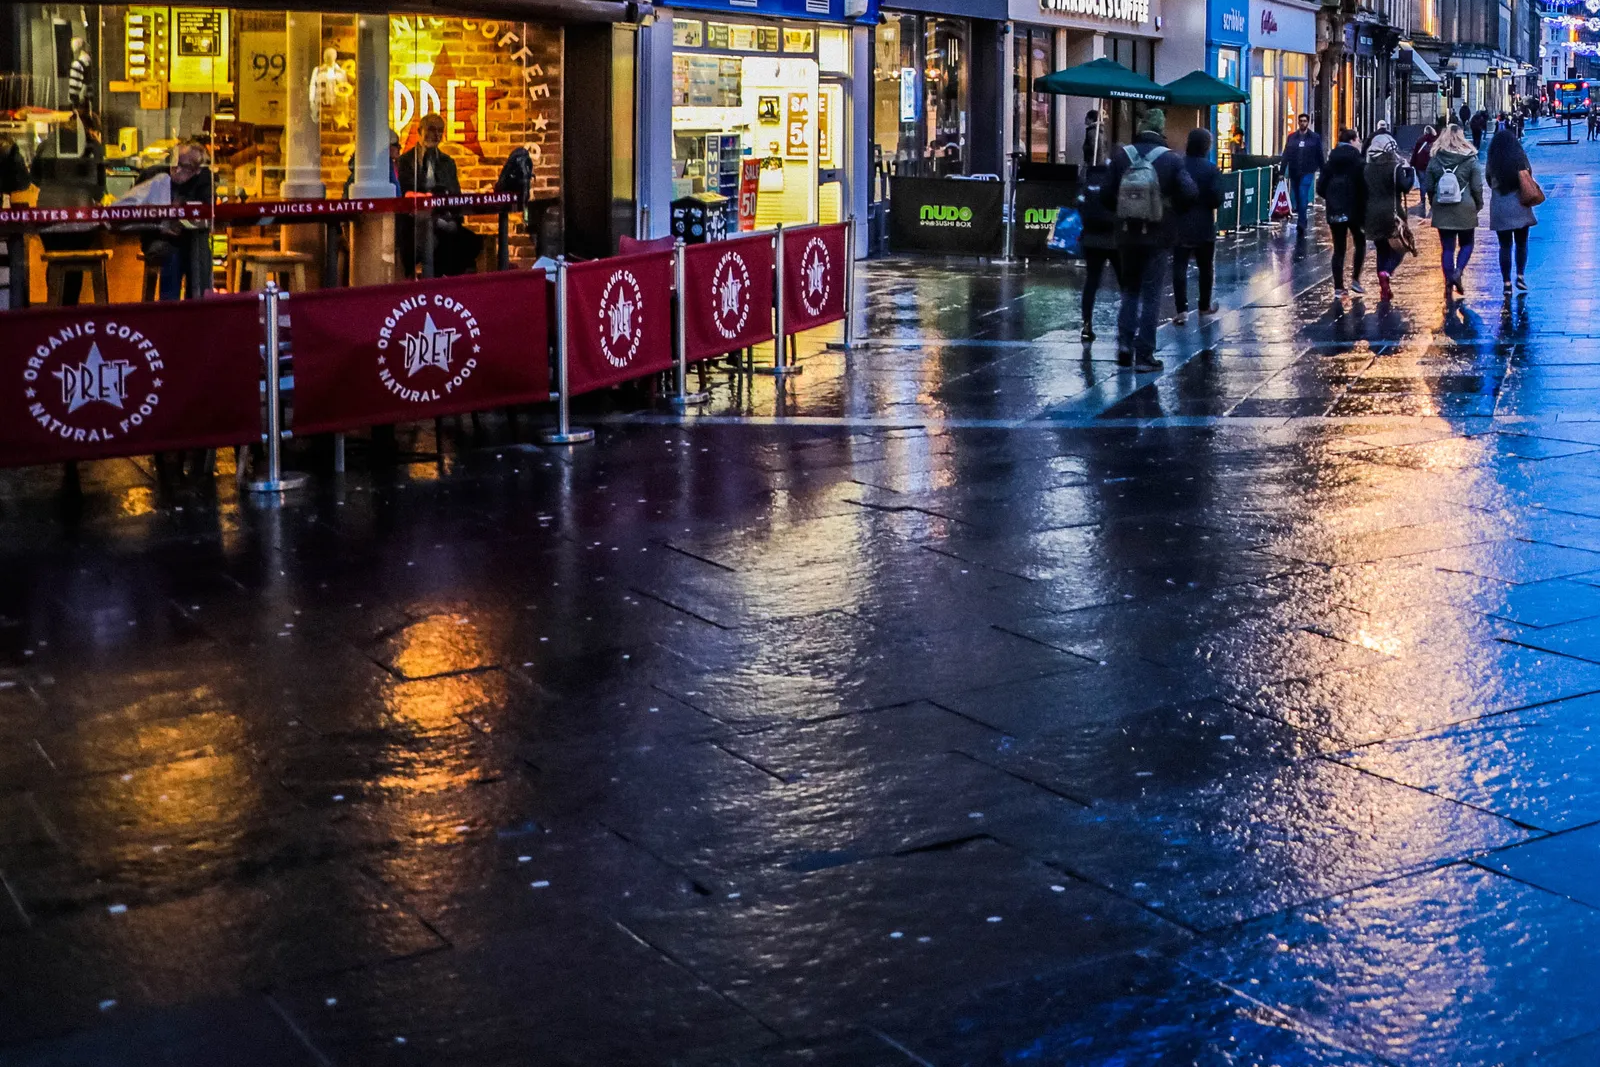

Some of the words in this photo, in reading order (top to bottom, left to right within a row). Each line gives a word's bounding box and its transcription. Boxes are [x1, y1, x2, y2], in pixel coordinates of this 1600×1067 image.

[790, 96, 826, 113] SAE
[91, 207, 186, 219] SANDWICHES
[271, 204, 313, 214] JUICES
[329, 202, 363, 211] LATTE
[431, 198, 446, 207] HOT
[448, 196, 474, 206] WRAPS
[483, 194, 511, 204] SALADS
[741, 192, 756, 217] 50
[920, 205, 973, 222] NUDO
[378, 294, 427, 349] ORGANIC
[434, 294, 480, 339] COFFEE
[24, 321, 95, 381] ORGANIC
[106, 322, 164, 371] COFFEE
[405, 328, 456, 368] PRET
[62, 359, 129, 403] PRET
[379, 368, 440, 402] NATURAL
[445, 358, 477, 393] FOOD
[29, 402, 114, 442] NATURAL
[120, 393, 159, 433] FOOD
